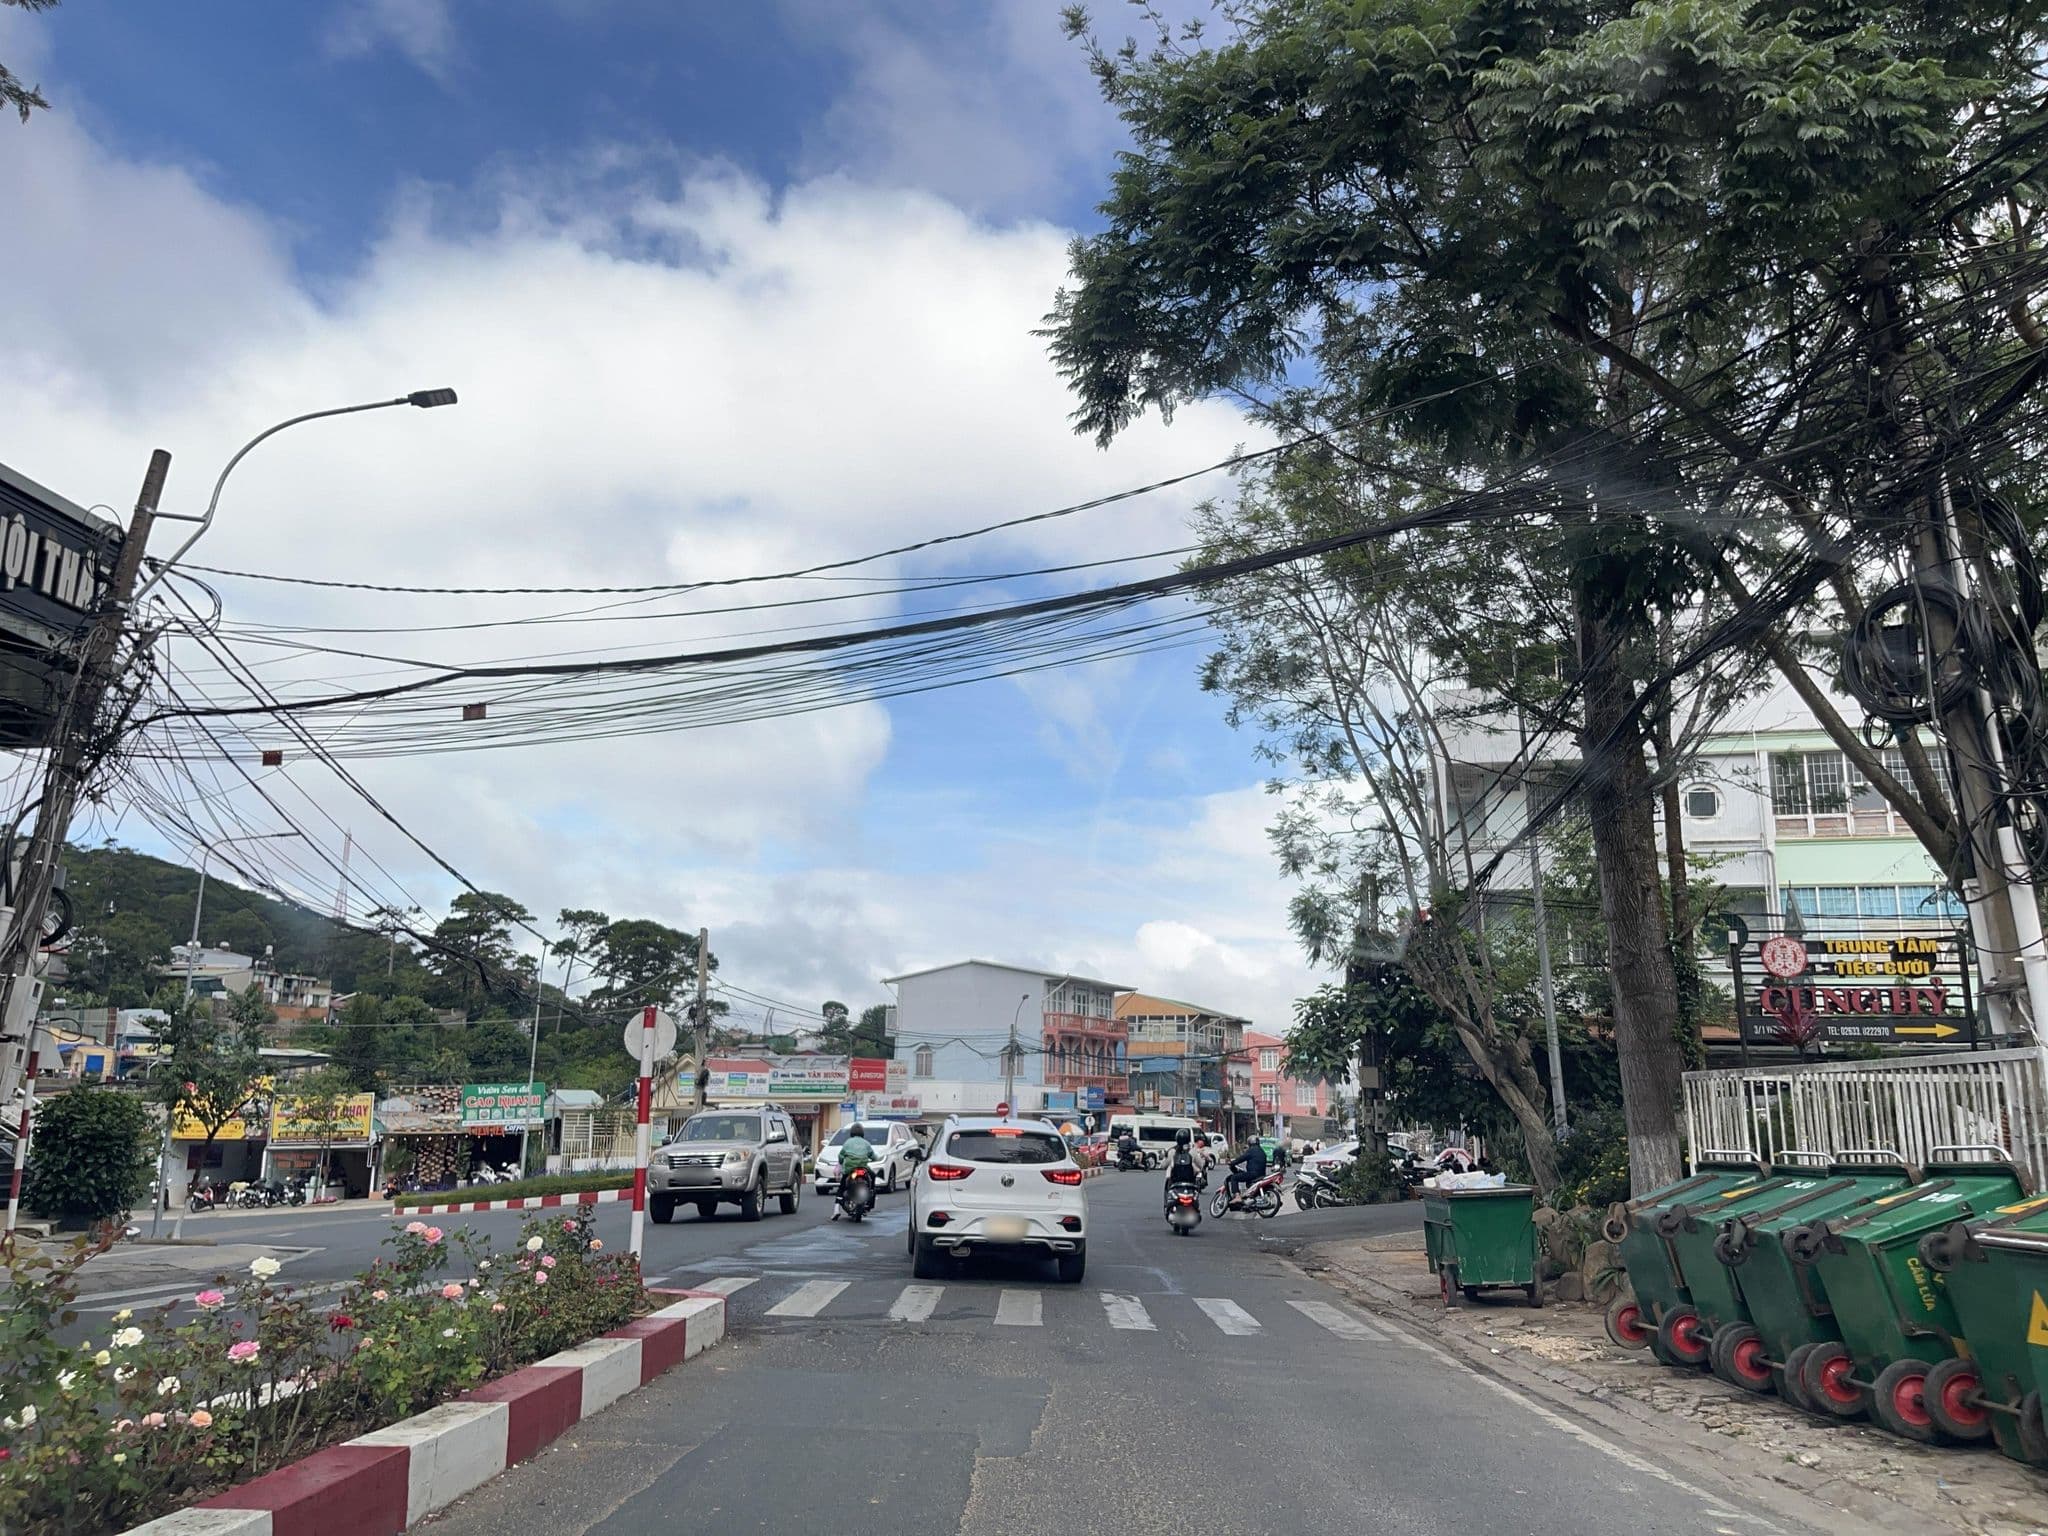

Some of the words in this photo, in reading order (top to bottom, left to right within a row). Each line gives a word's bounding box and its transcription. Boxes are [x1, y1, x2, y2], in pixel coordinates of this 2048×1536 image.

[1824, 939, 1889, 954] TRUNG
[1896, 937, 1937, 954] TÂM
[1836, 959, 1878, 977] TIỆC
[1883, 959, 1930, 975] CƯỚI
[465, 1096, 495, 1108] CAO
